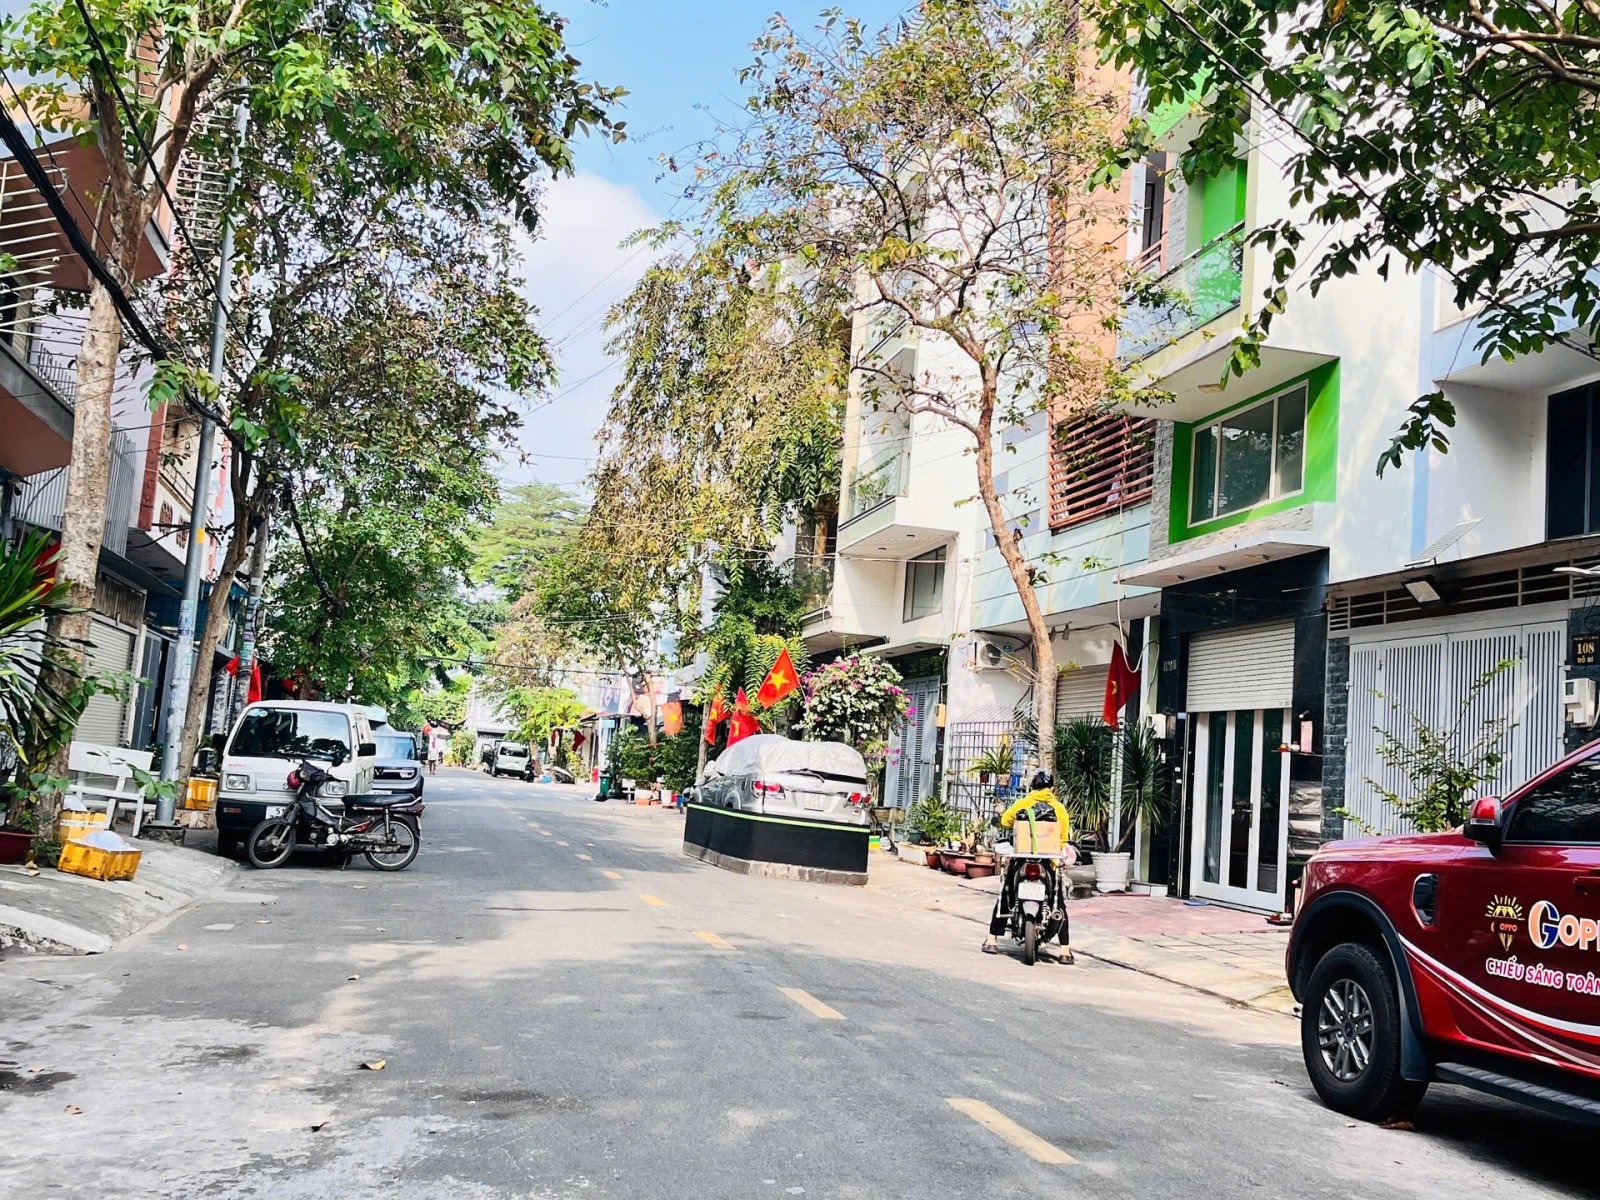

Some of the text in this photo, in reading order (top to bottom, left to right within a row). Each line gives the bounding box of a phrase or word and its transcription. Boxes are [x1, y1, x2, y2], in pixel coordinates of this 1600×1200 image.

[1577, 642, 1594, 654] 108
[1528, 900, 1600, 951] GOP
[1486, 955, 1524, 980] CHIẾU
[1525, 963, 1563, 989] SÁNG
